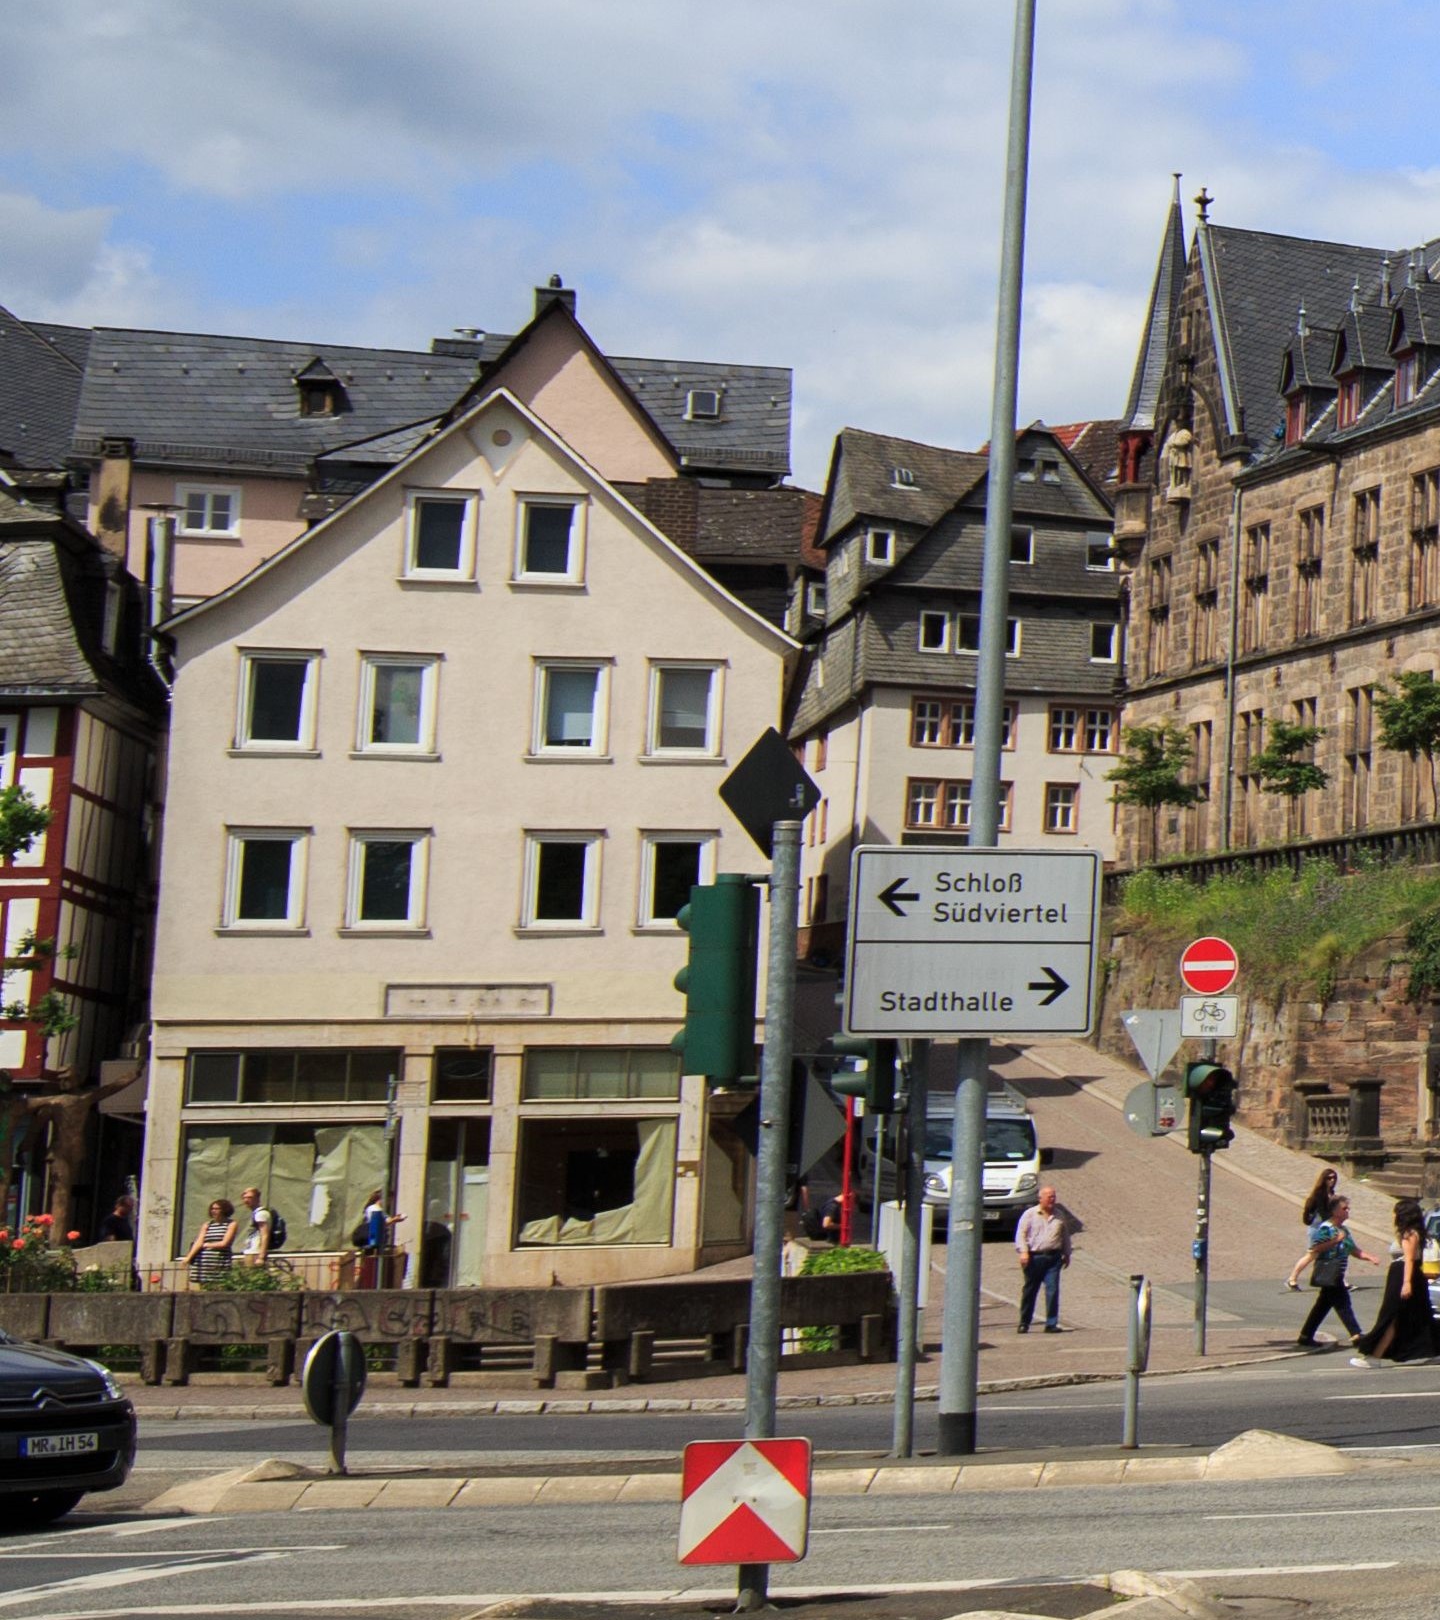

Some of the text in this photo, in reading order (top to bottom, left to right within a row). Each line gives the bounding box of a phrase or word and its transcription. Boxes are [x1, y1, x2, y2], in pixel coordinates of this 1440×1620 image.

[935, 872, 1022, 893] Schloß
[933, 902, 1068, 923] Südviertel
[880, 991, 1014, 1012] Stadthalle
[1200, 1023, 1218, 1032] frei
[78, 1435, 94, 1449] 54
